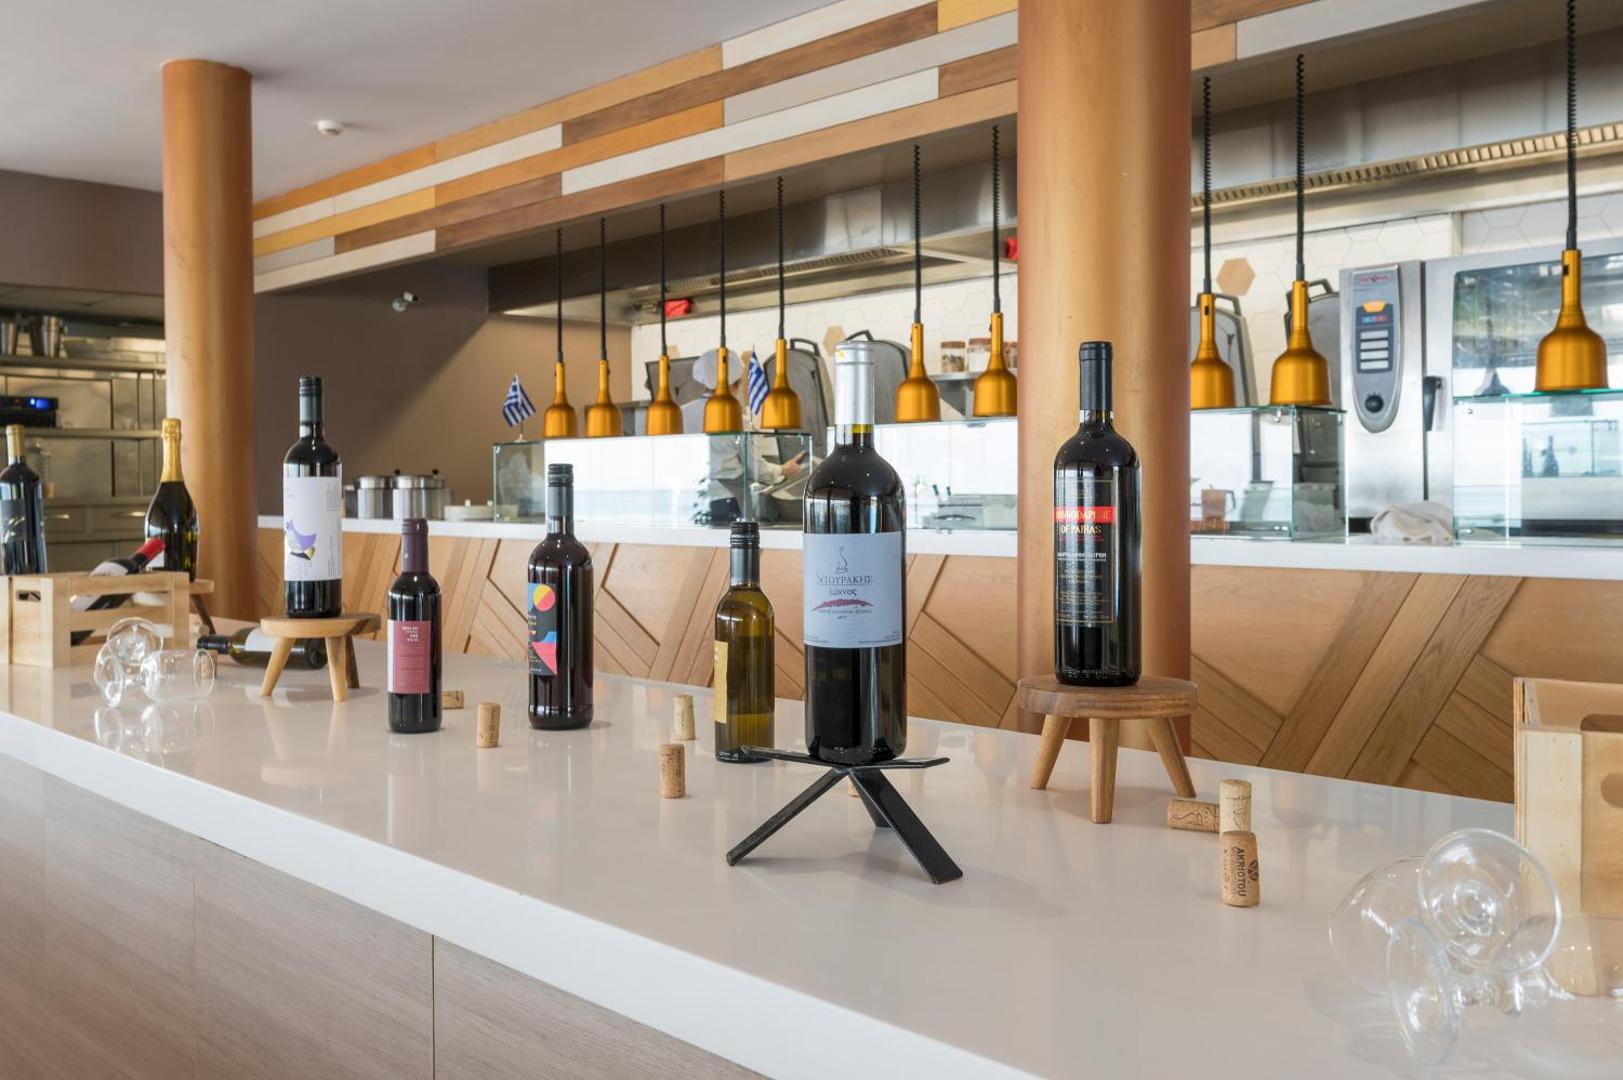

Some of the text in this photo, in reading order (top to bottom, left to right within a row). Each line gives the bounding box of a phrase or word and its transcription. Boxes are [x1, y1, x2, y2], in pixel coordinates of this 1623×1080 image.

[1060, 524, 1102, 535] OF PATRAS
[1236, 848, 1246, 897] AKRIOTOU
